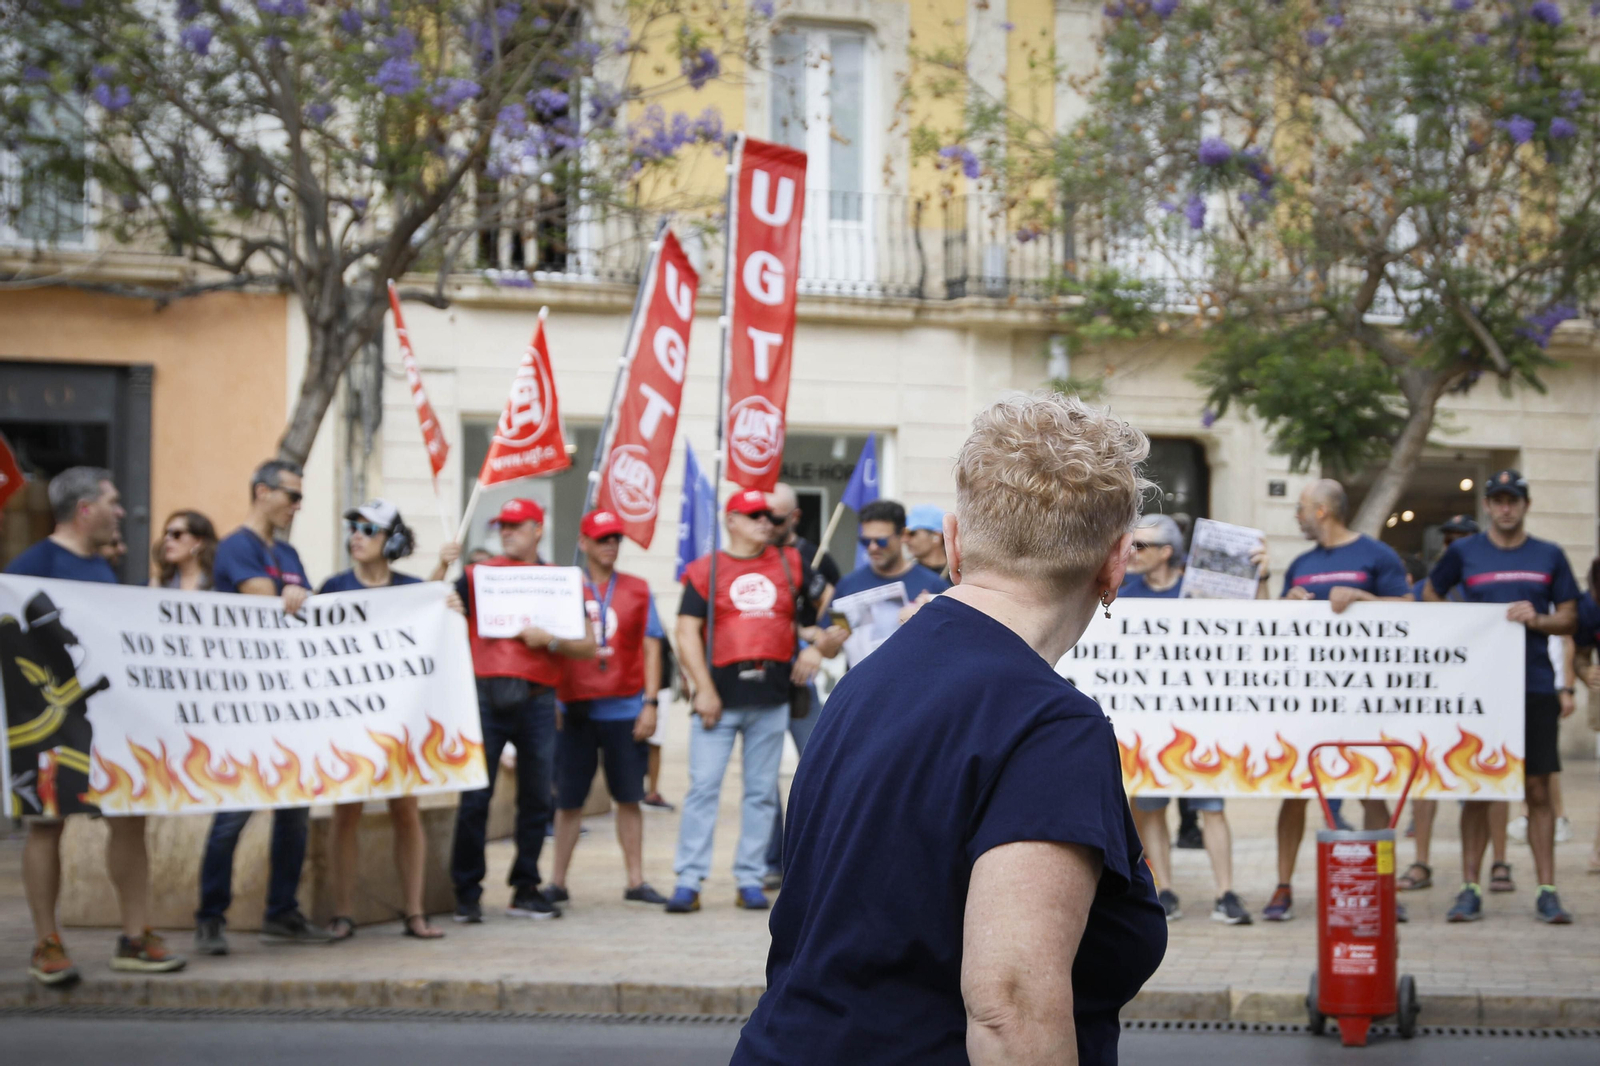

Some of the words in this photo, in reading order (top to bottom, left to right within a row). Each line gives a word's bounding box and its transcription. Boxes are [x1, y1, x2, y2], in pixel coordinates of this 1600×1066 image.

[741, 169, 796, 382] UGT
[636, 261, 692, 440] UGT
[159, 600, 203, 625] SIN
[1121, 618, 1170, 635] LAS
[1181, 619, 1409, 638] INSTALACIONES
[120, 630, 155, 655] NO
[162, 634, 194, 658] SE
[201, 637, 289, 661] PUEDE
[299, 636, 362, 659] DAR
[371, 626, 418, 650] UN
[1072, 643, 1126, 660] DEL
[1134, 643, 1252, 661] PARQUE
[1261, 645, 1300, 662] DE
[1308, 645, 1468, 664] BOMBEROS
[126, 665, 249, 692] SERVICIO
[258, 670, 294, 691] DE
[303, 656, 435, 690] CALIDAD
[1094, 668, 1149, 686] SON
[1161, 669, 1193, 687] LA
[1204, 664, 1374, 688] VERGÜENZA
[1386, 671, 1438, 689] DEL
[175, 700, 205, 724] AL
[212, 692, 386, 725] CIUDADANO
[1311, 695, 1347, 713] DE
[1354, 692, 1486, 715] ALMERÍA
